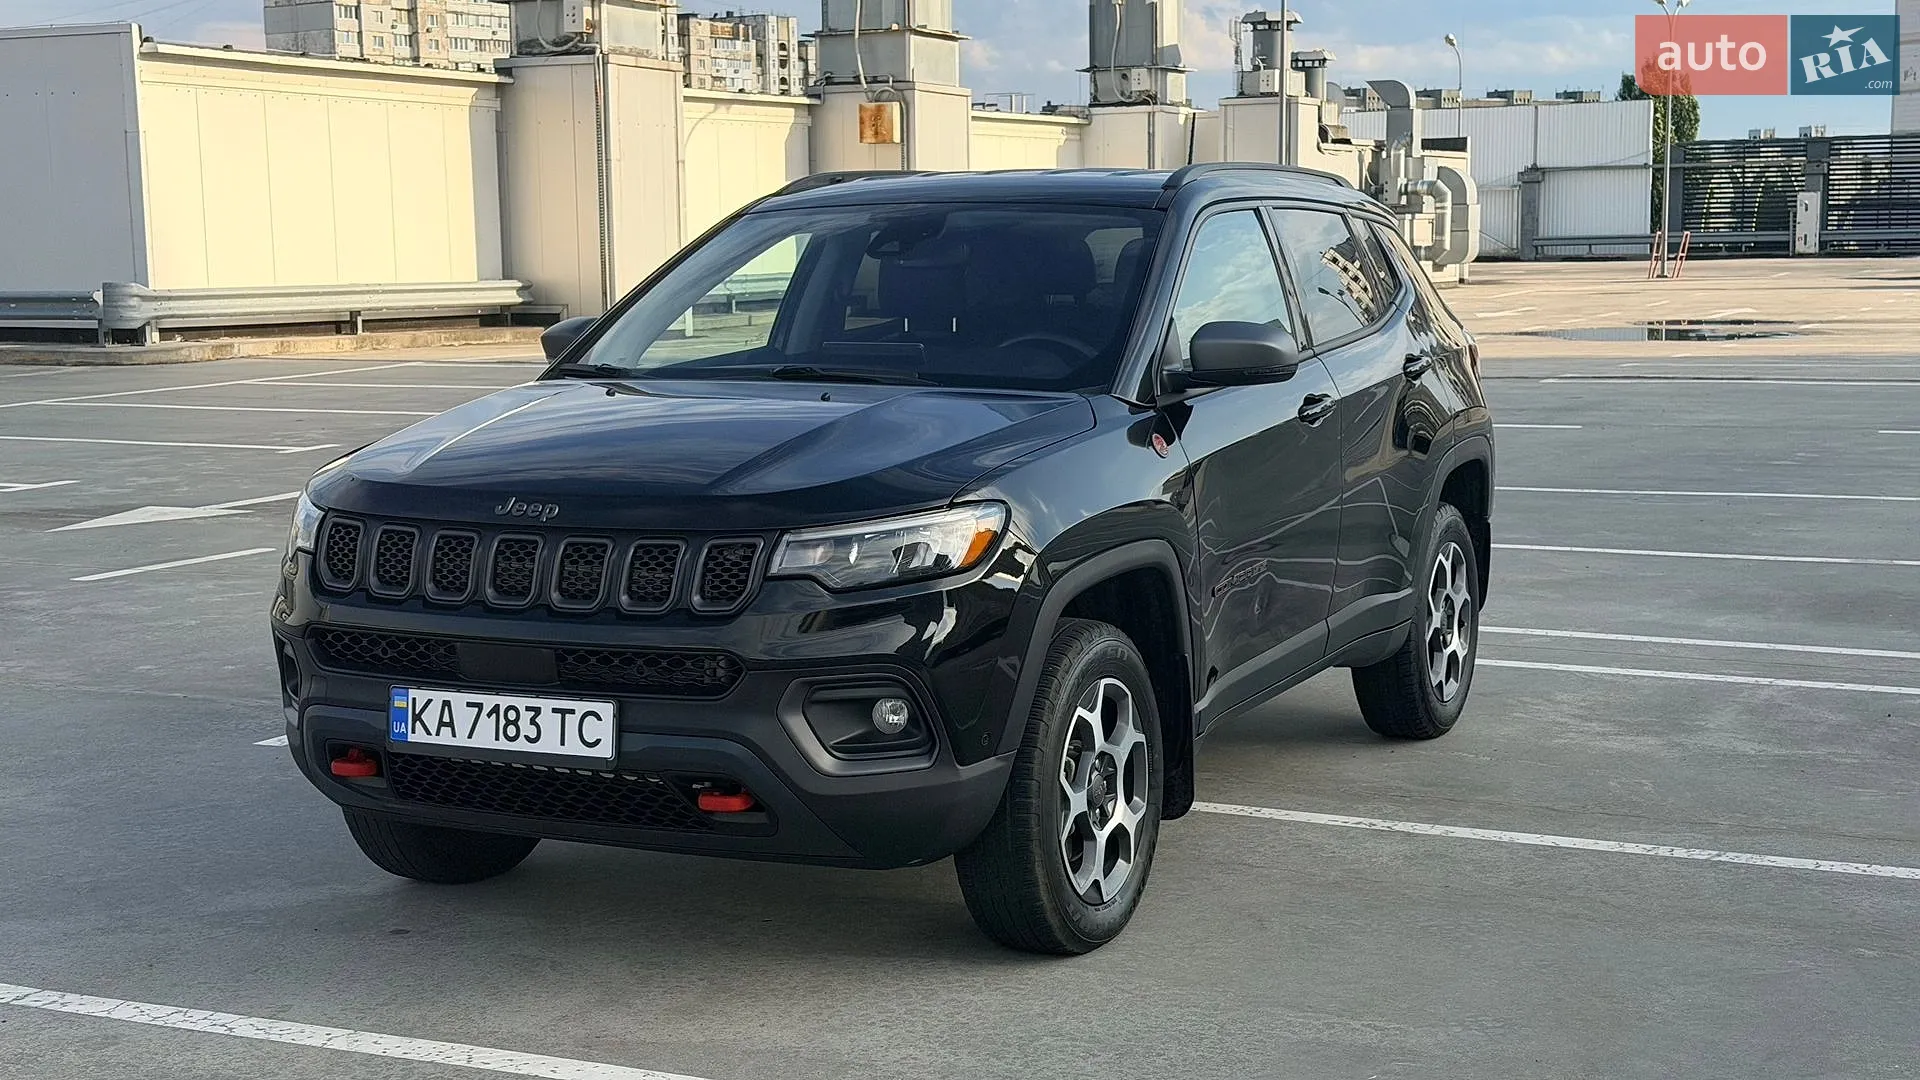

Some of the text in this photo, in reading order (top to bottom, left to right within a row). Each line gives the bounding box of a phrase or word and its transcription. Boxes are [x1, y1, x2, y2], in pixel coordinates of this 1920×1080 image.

[494, 496, 559, 522] Jeep
[393, 721, 407, 734] UA
[410, 696, 604, 749] KA 7183 TC
